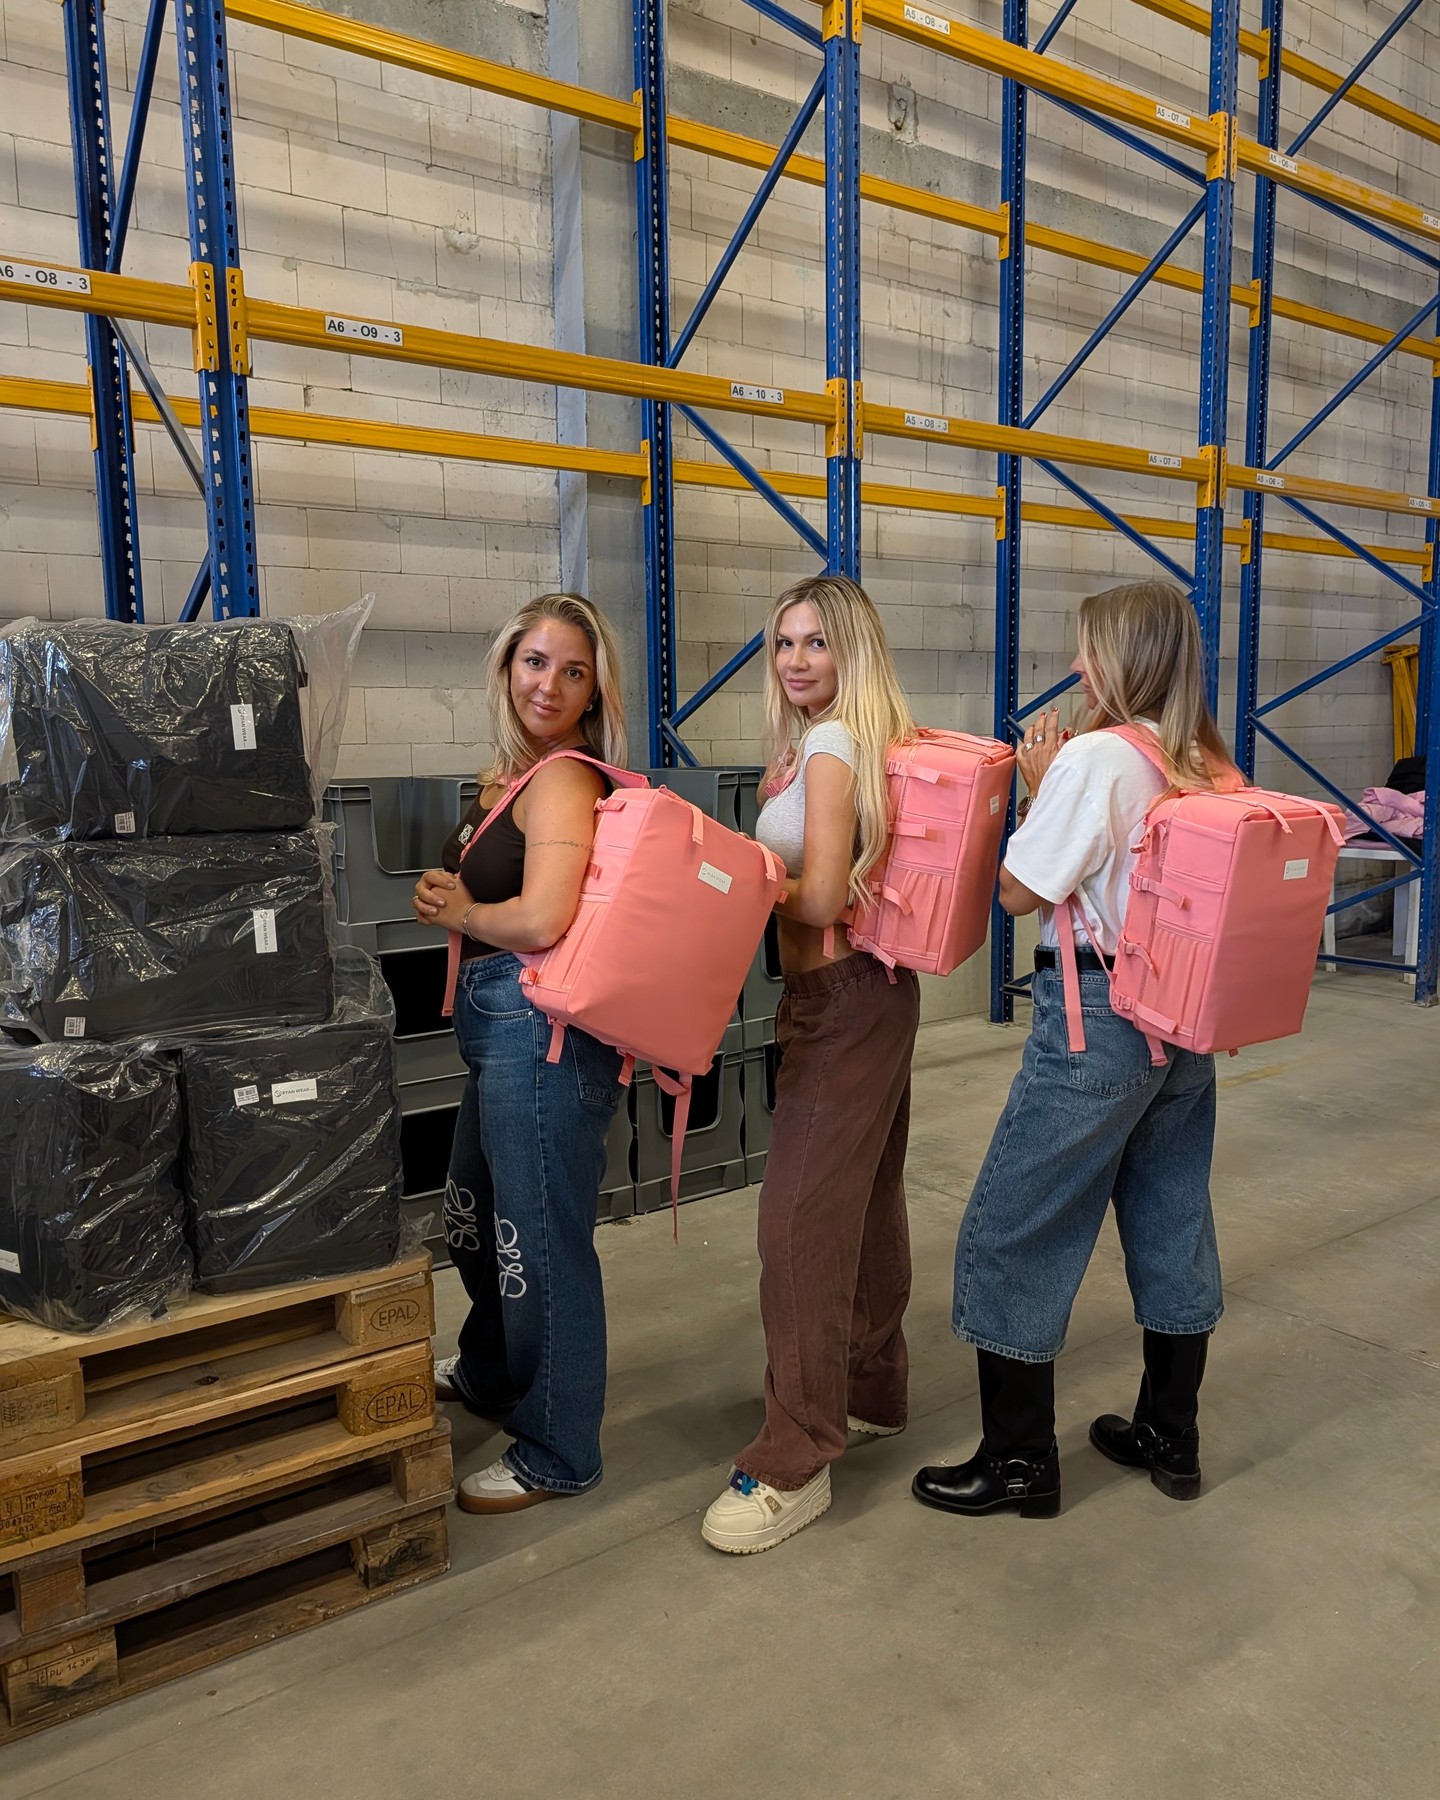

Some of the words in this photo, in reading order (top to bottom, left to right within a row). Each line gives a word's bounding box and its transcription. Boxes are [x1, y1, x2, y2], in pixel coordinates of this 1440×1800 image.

[906, 8, 916, 19] A5
[79, 278, 87, 290] 3
[328, 320, 345, 332] A6
[394, 331, 400, 342] 3
[732, 386, 744, 396] A6
[756, 389, 766, 399] 10
[777, 392, 782, 401] 3
[906, 415, 916, 425] A5
[943, 422, 947, 431] 3
[1150, 455, 1157, 463] A5
[379, 1305, 415, 1326] EPAL
[375, 1390, 420, 1418] EPAL
